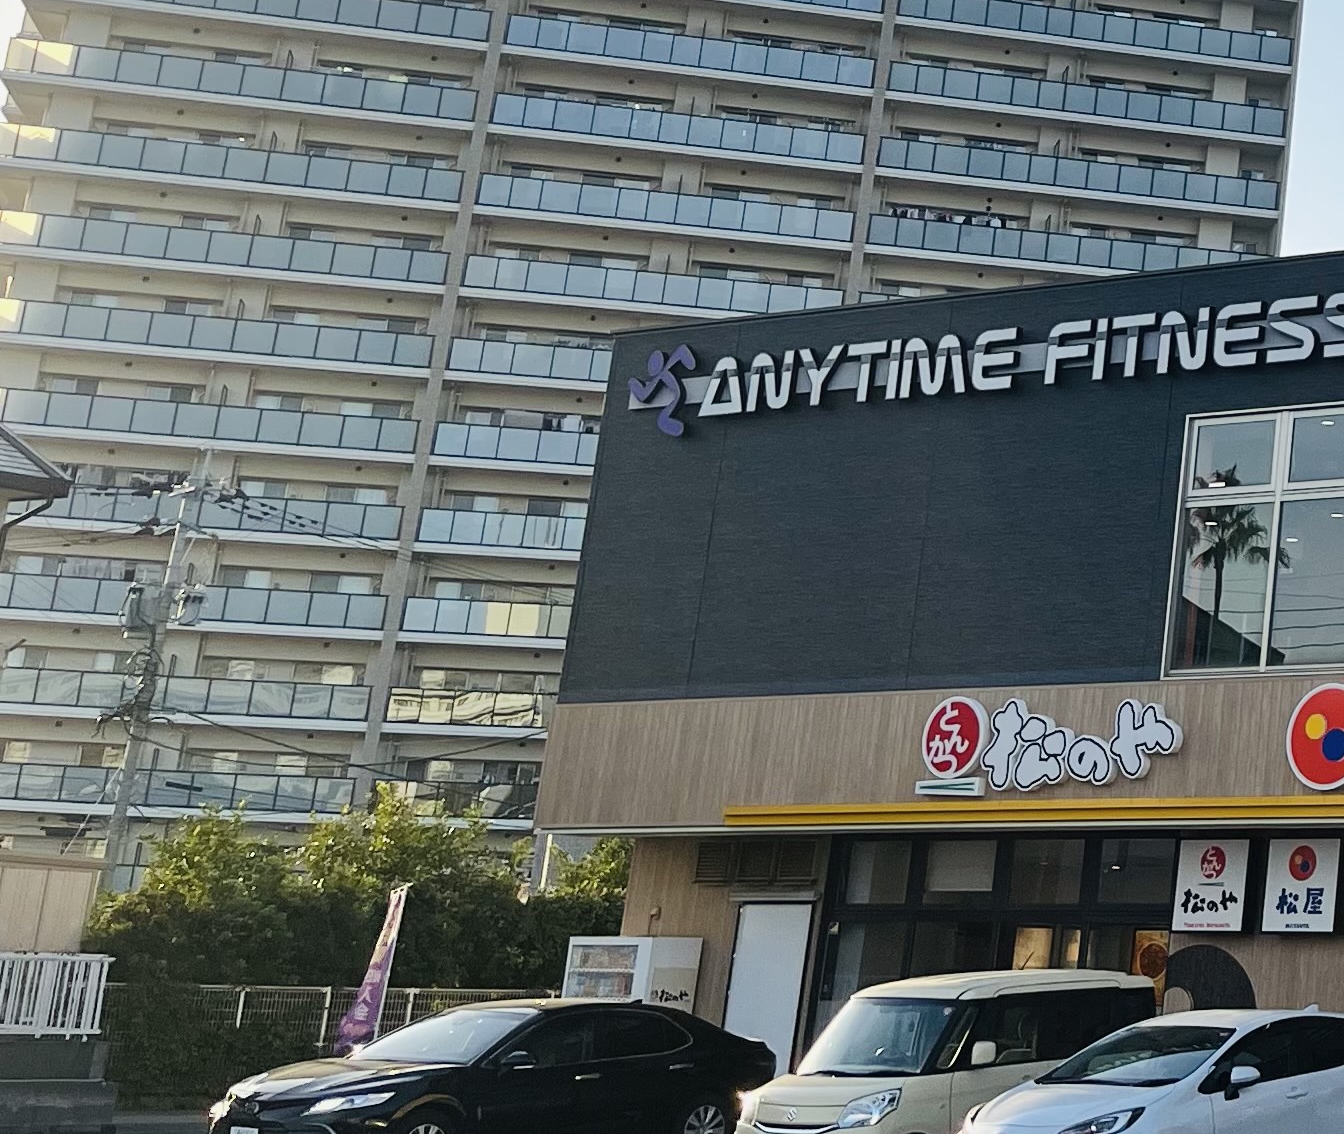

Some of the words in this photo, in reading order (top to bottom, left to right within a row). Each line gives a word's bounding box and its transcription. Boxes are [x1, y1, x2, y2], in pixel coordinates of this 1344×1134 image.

[697, 327, 1022, 417] ANYTIME
[927, 702, 970, 772] とんかつ
[981, 698, 1180, 792] 松のや
[1181, 888, 1239, 914] 松のや
[1276, 887, 1324, 915] 松屋
